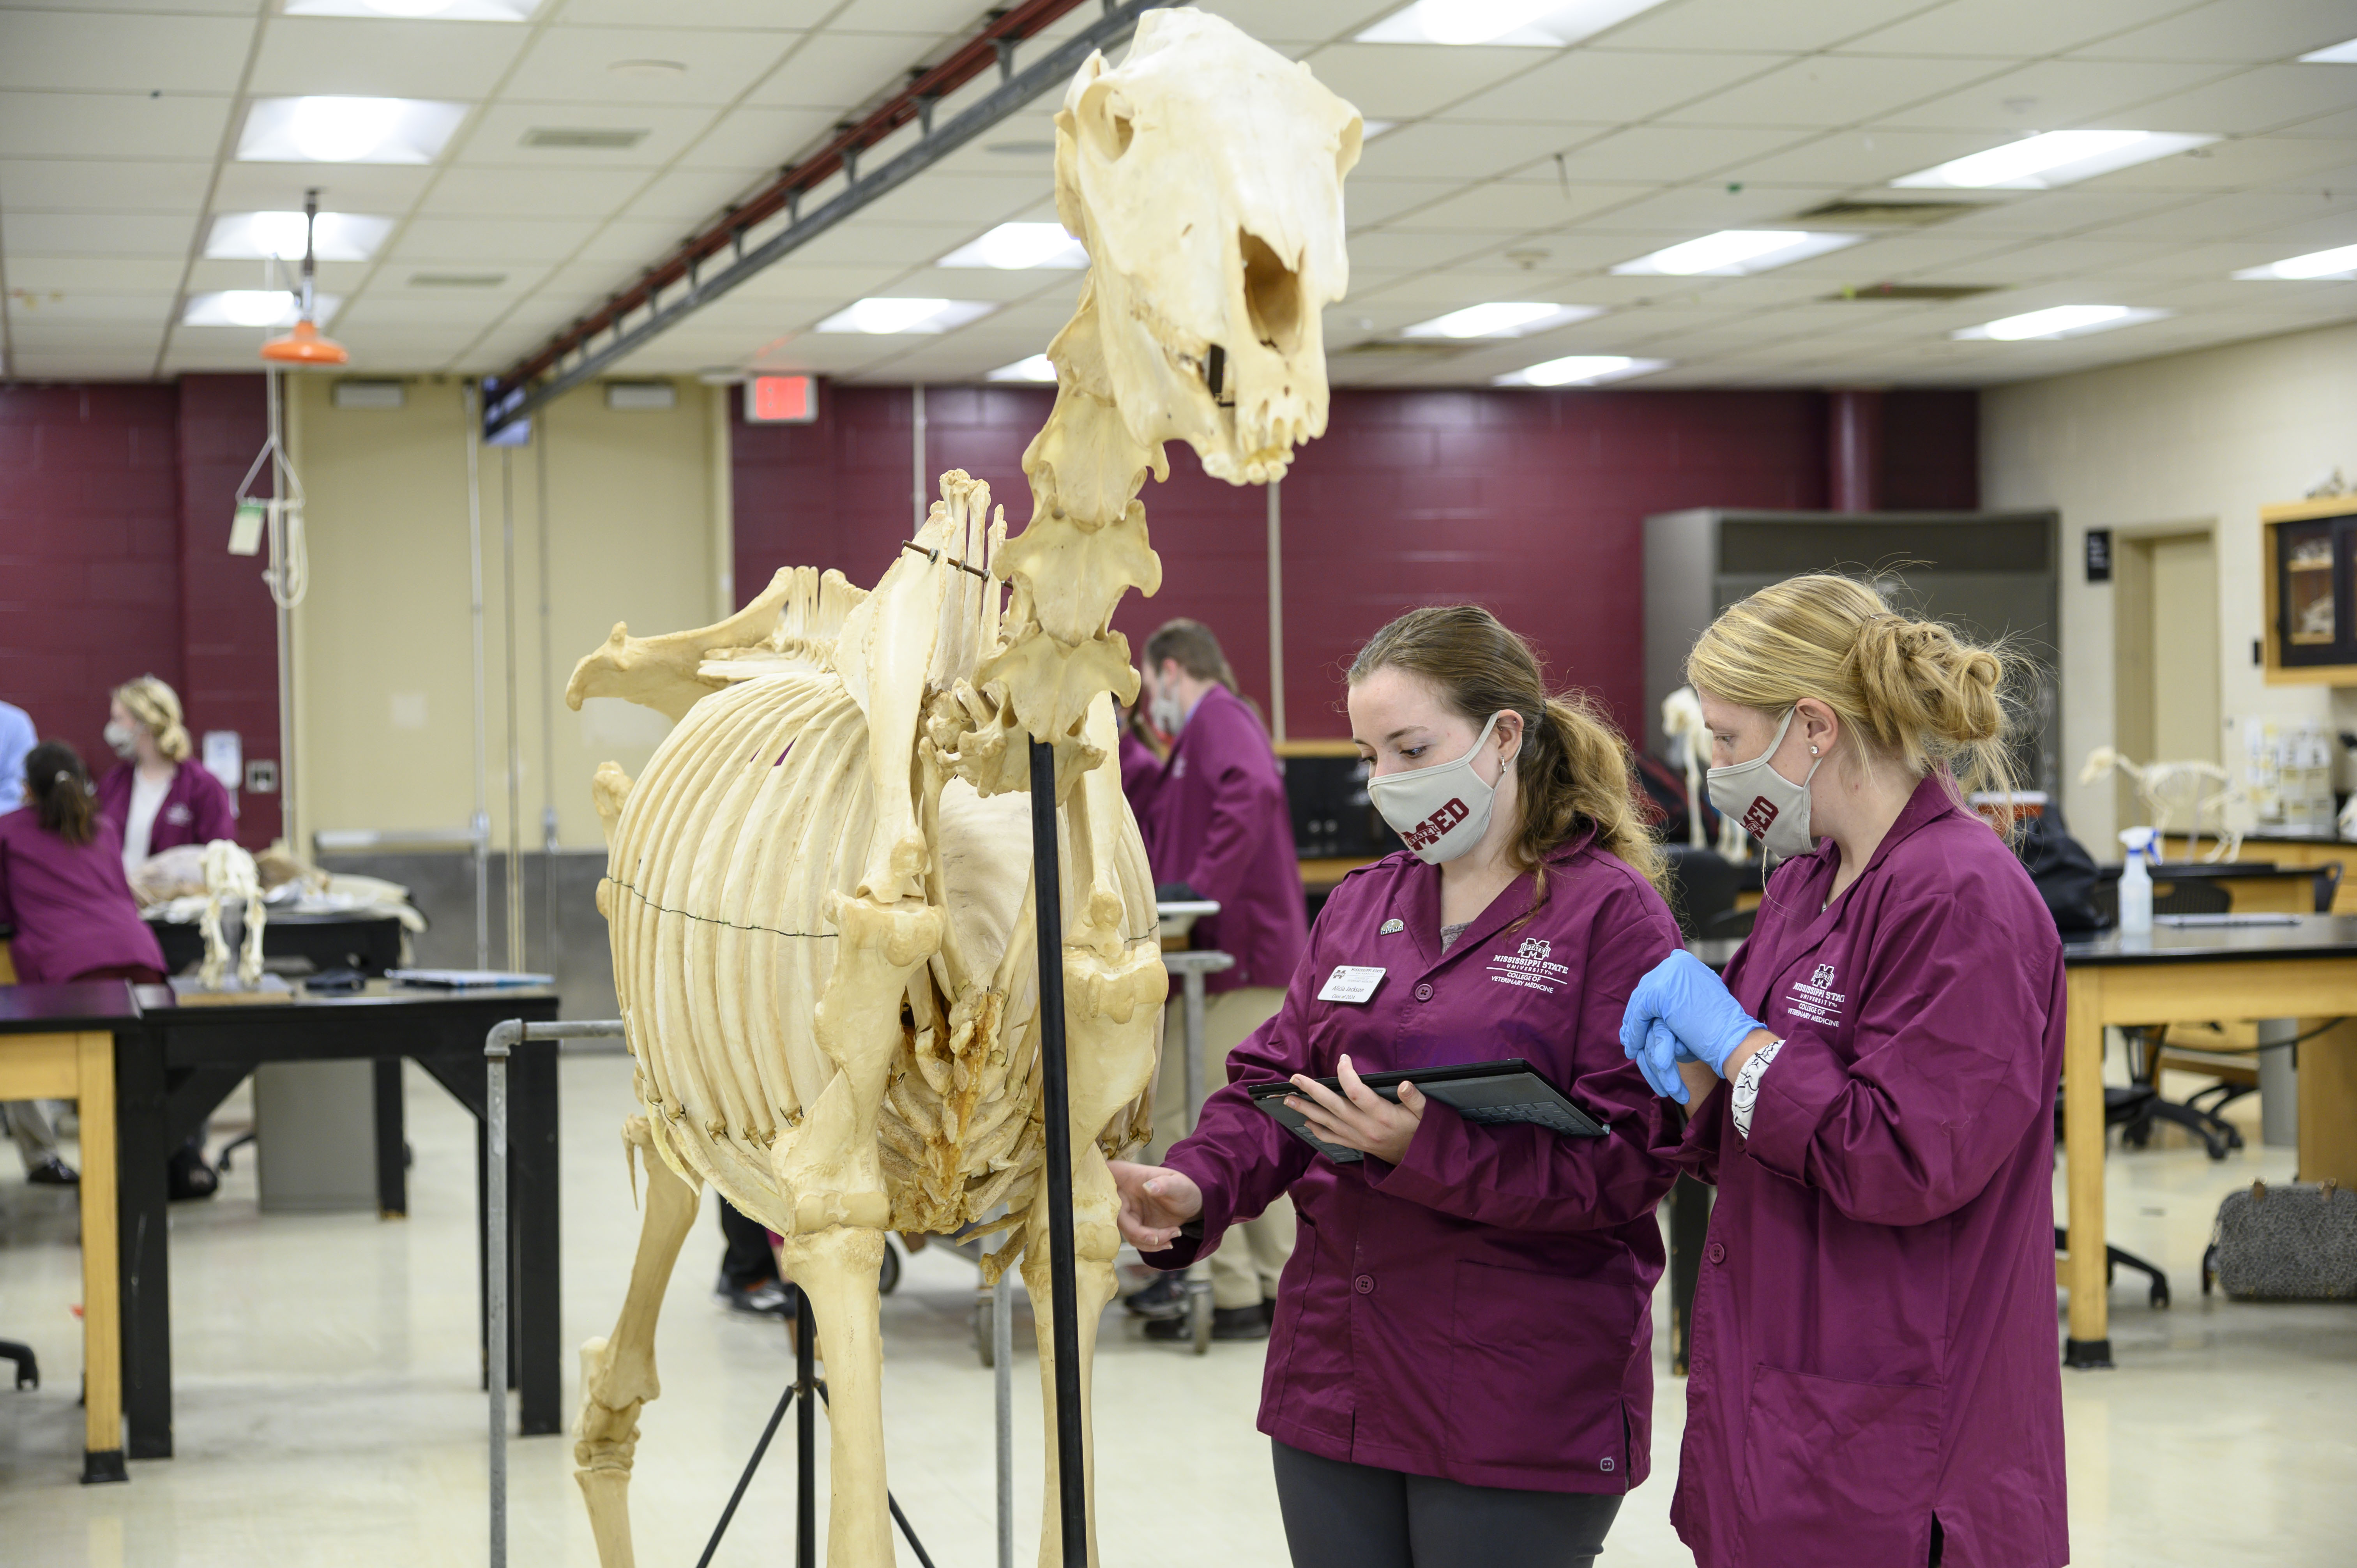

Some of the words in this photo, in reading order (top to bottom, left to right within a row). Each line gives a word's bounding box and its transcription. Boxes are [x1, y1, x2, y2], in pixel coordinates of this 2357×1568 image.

[1396, 798, 1469, 851] MED
[1408, 829, 1433, 844] STATE
[1525, 945, 1544, 954] STATE
[1493, 955, 1541, 968] MISSISSIPPI
[1542, 961, 1569, 974] STATE
[1491, 976, 1524, 986] VETERINARY
[1524, 982, 1554, 993] MEDICINE
[1507, 972, 1532, 981] COLLEGE
[1793, 982, 1825, 998] MISSISSIPPI
[1826, 991, 1845, 1002] STAT
[1799, 1003, 1816, 1013] COLLEGE
[1788, 1008, 1811, 1019] VETERINARY
[1811, 1015, 1839, 1027] MEDICINE
